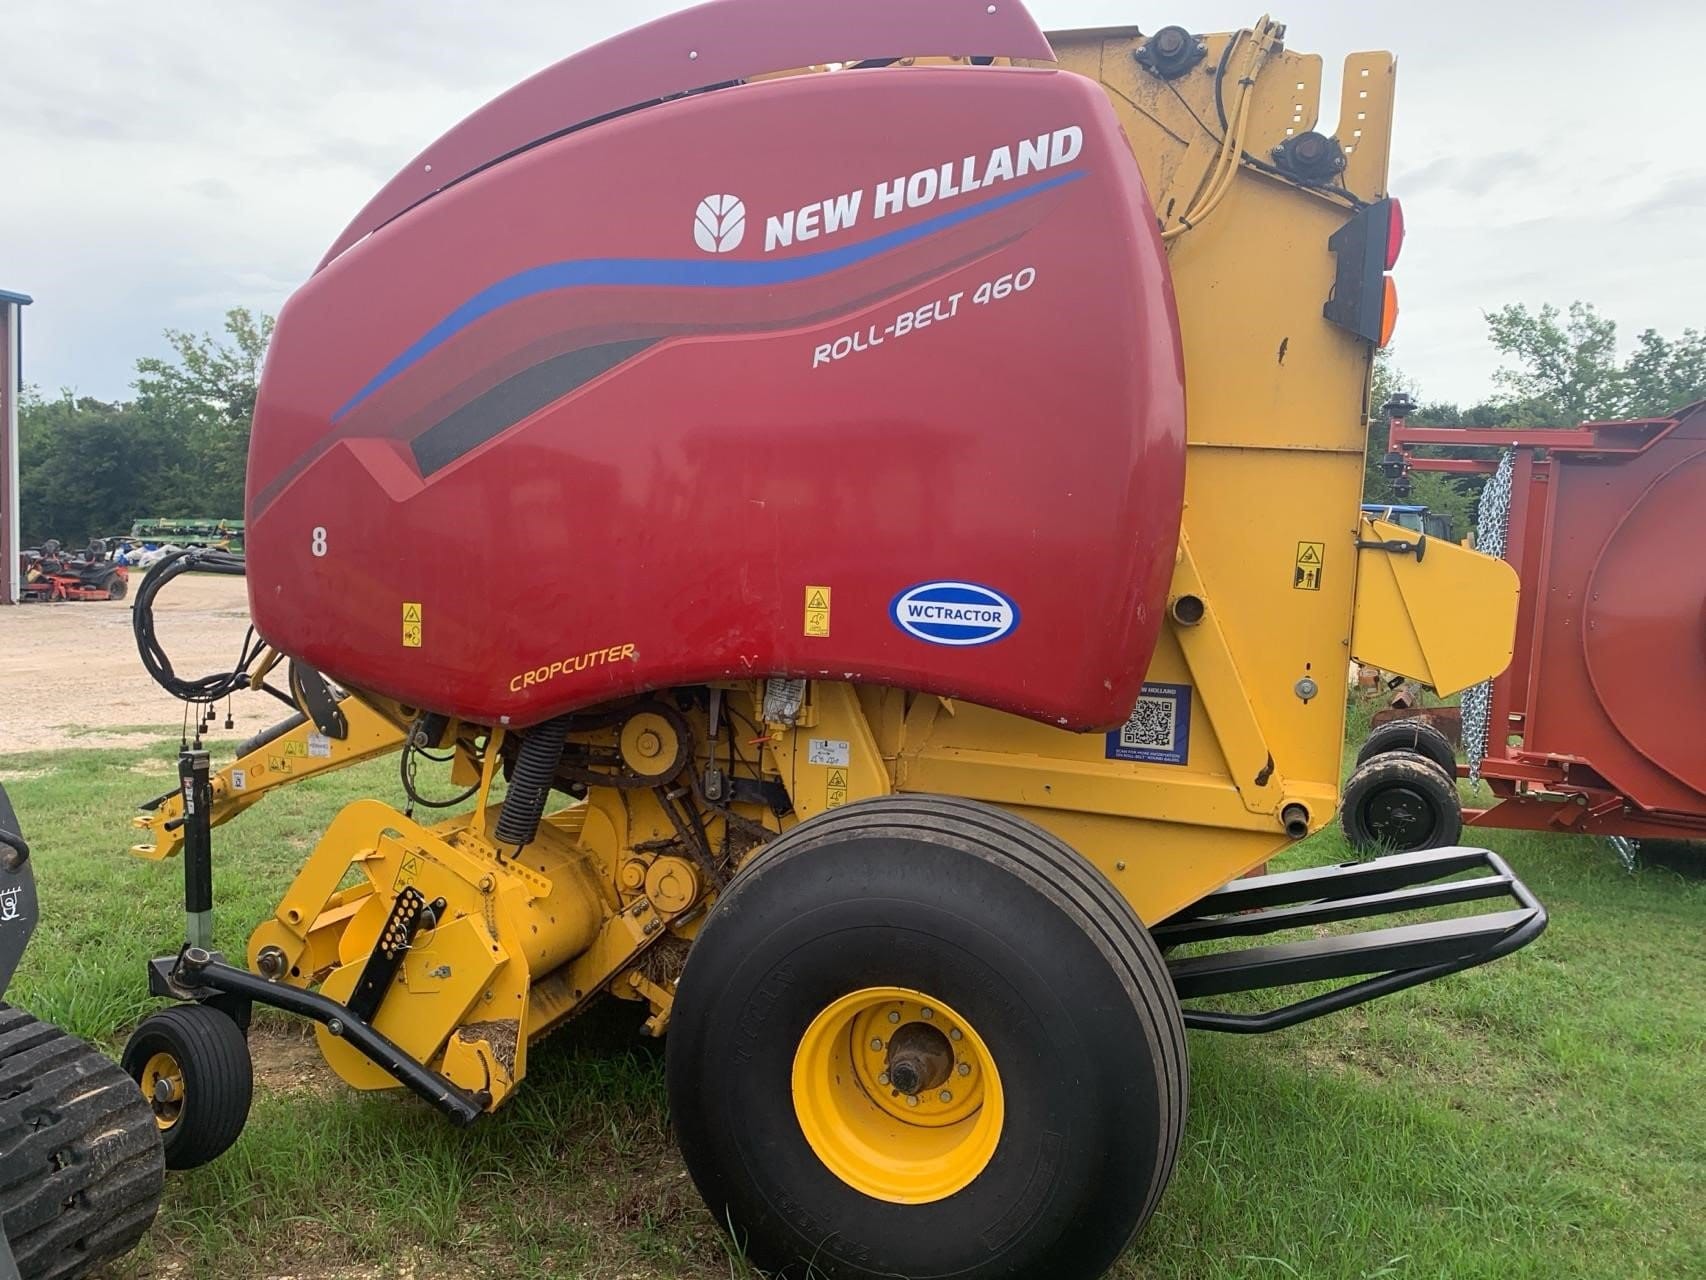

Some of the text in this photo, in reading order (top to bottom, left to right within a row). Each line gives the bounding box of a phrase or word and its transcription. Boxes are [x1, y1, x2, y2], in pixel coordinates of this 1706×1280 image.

[764, 125, 1084, 252] NEW HOLLAND
[812, 267, 1036, 368] ROLL-BELT 460
[311, 526, 328, 557] 8
[510, 643, 635, 692] CROPCUTTER
